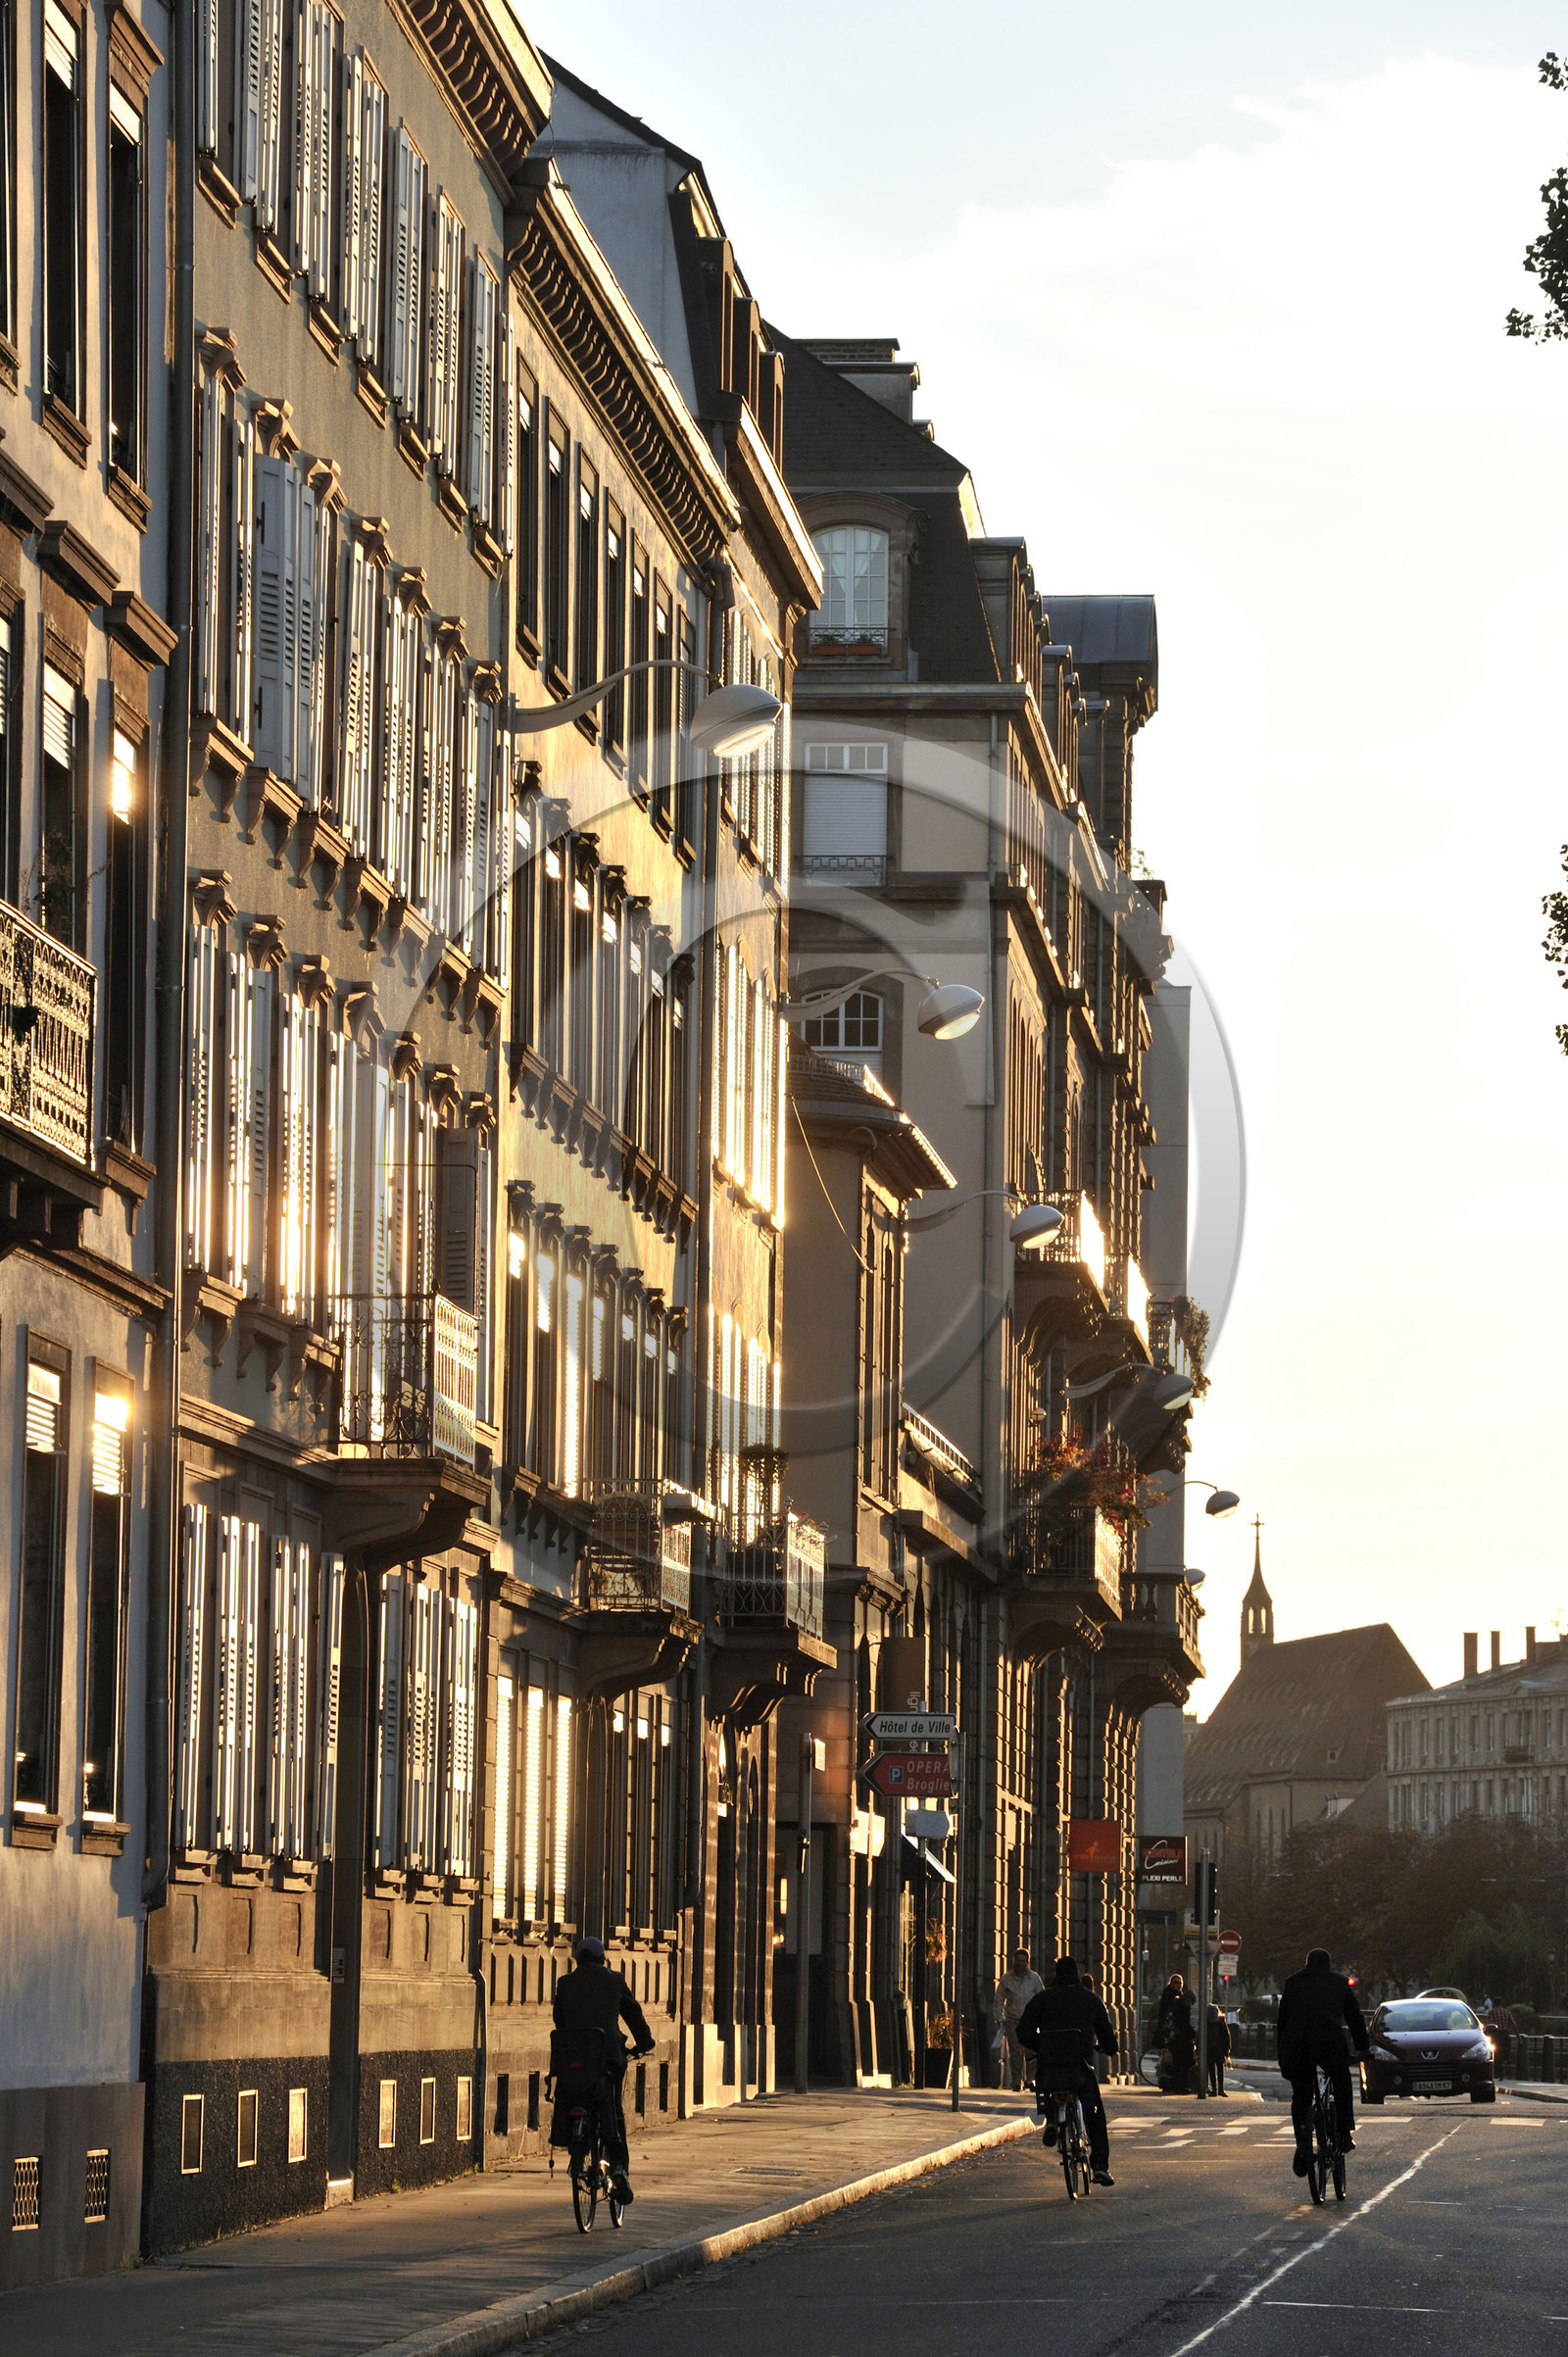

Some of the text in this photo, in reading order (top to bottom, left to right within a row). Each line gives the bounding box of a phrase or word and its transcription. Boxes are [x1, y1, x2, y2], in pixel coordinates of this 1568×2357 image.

[907, 1692, 921, 1713] lign
[879, 1721, 951, 1733] Hôtel de Ville
[907, 1778, 950, 1793] Broglie
